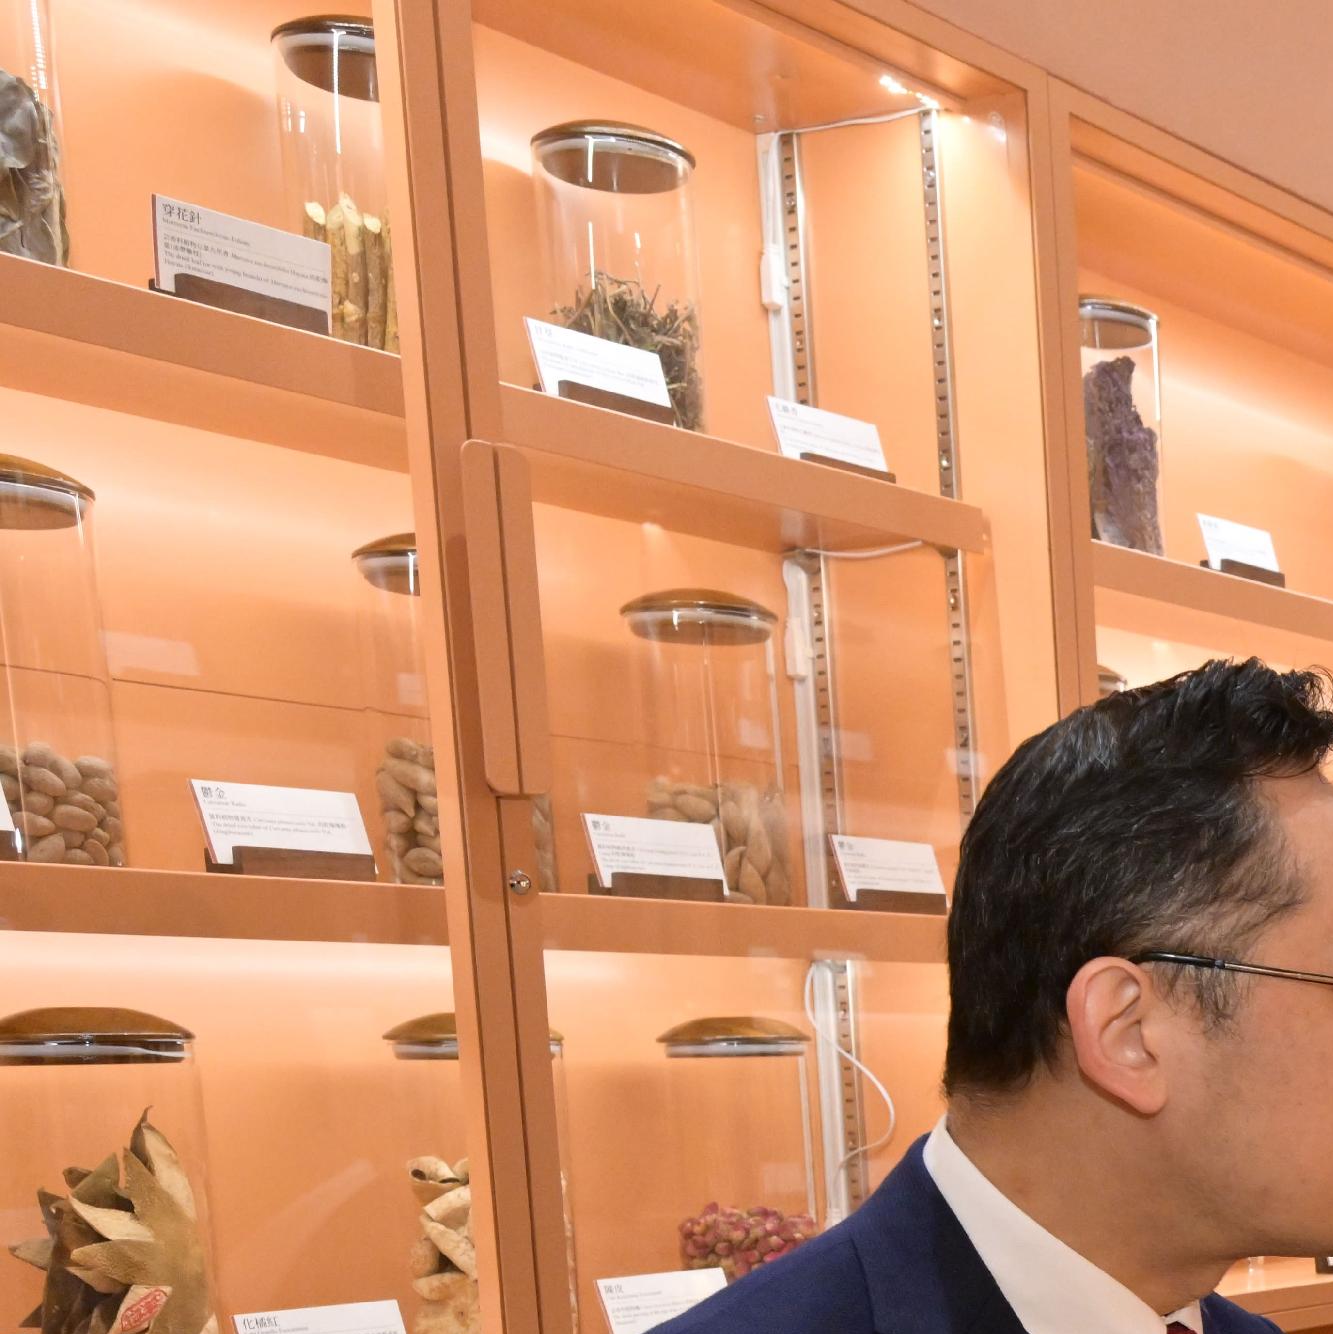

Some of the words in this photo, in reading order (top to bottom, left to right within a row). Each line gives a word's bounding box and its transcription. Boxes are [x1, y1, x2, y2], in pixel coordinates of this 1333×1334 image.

[162, 203, 201, 225] 穿花針
[242, 1315, 280, 1330] 化橘紅
